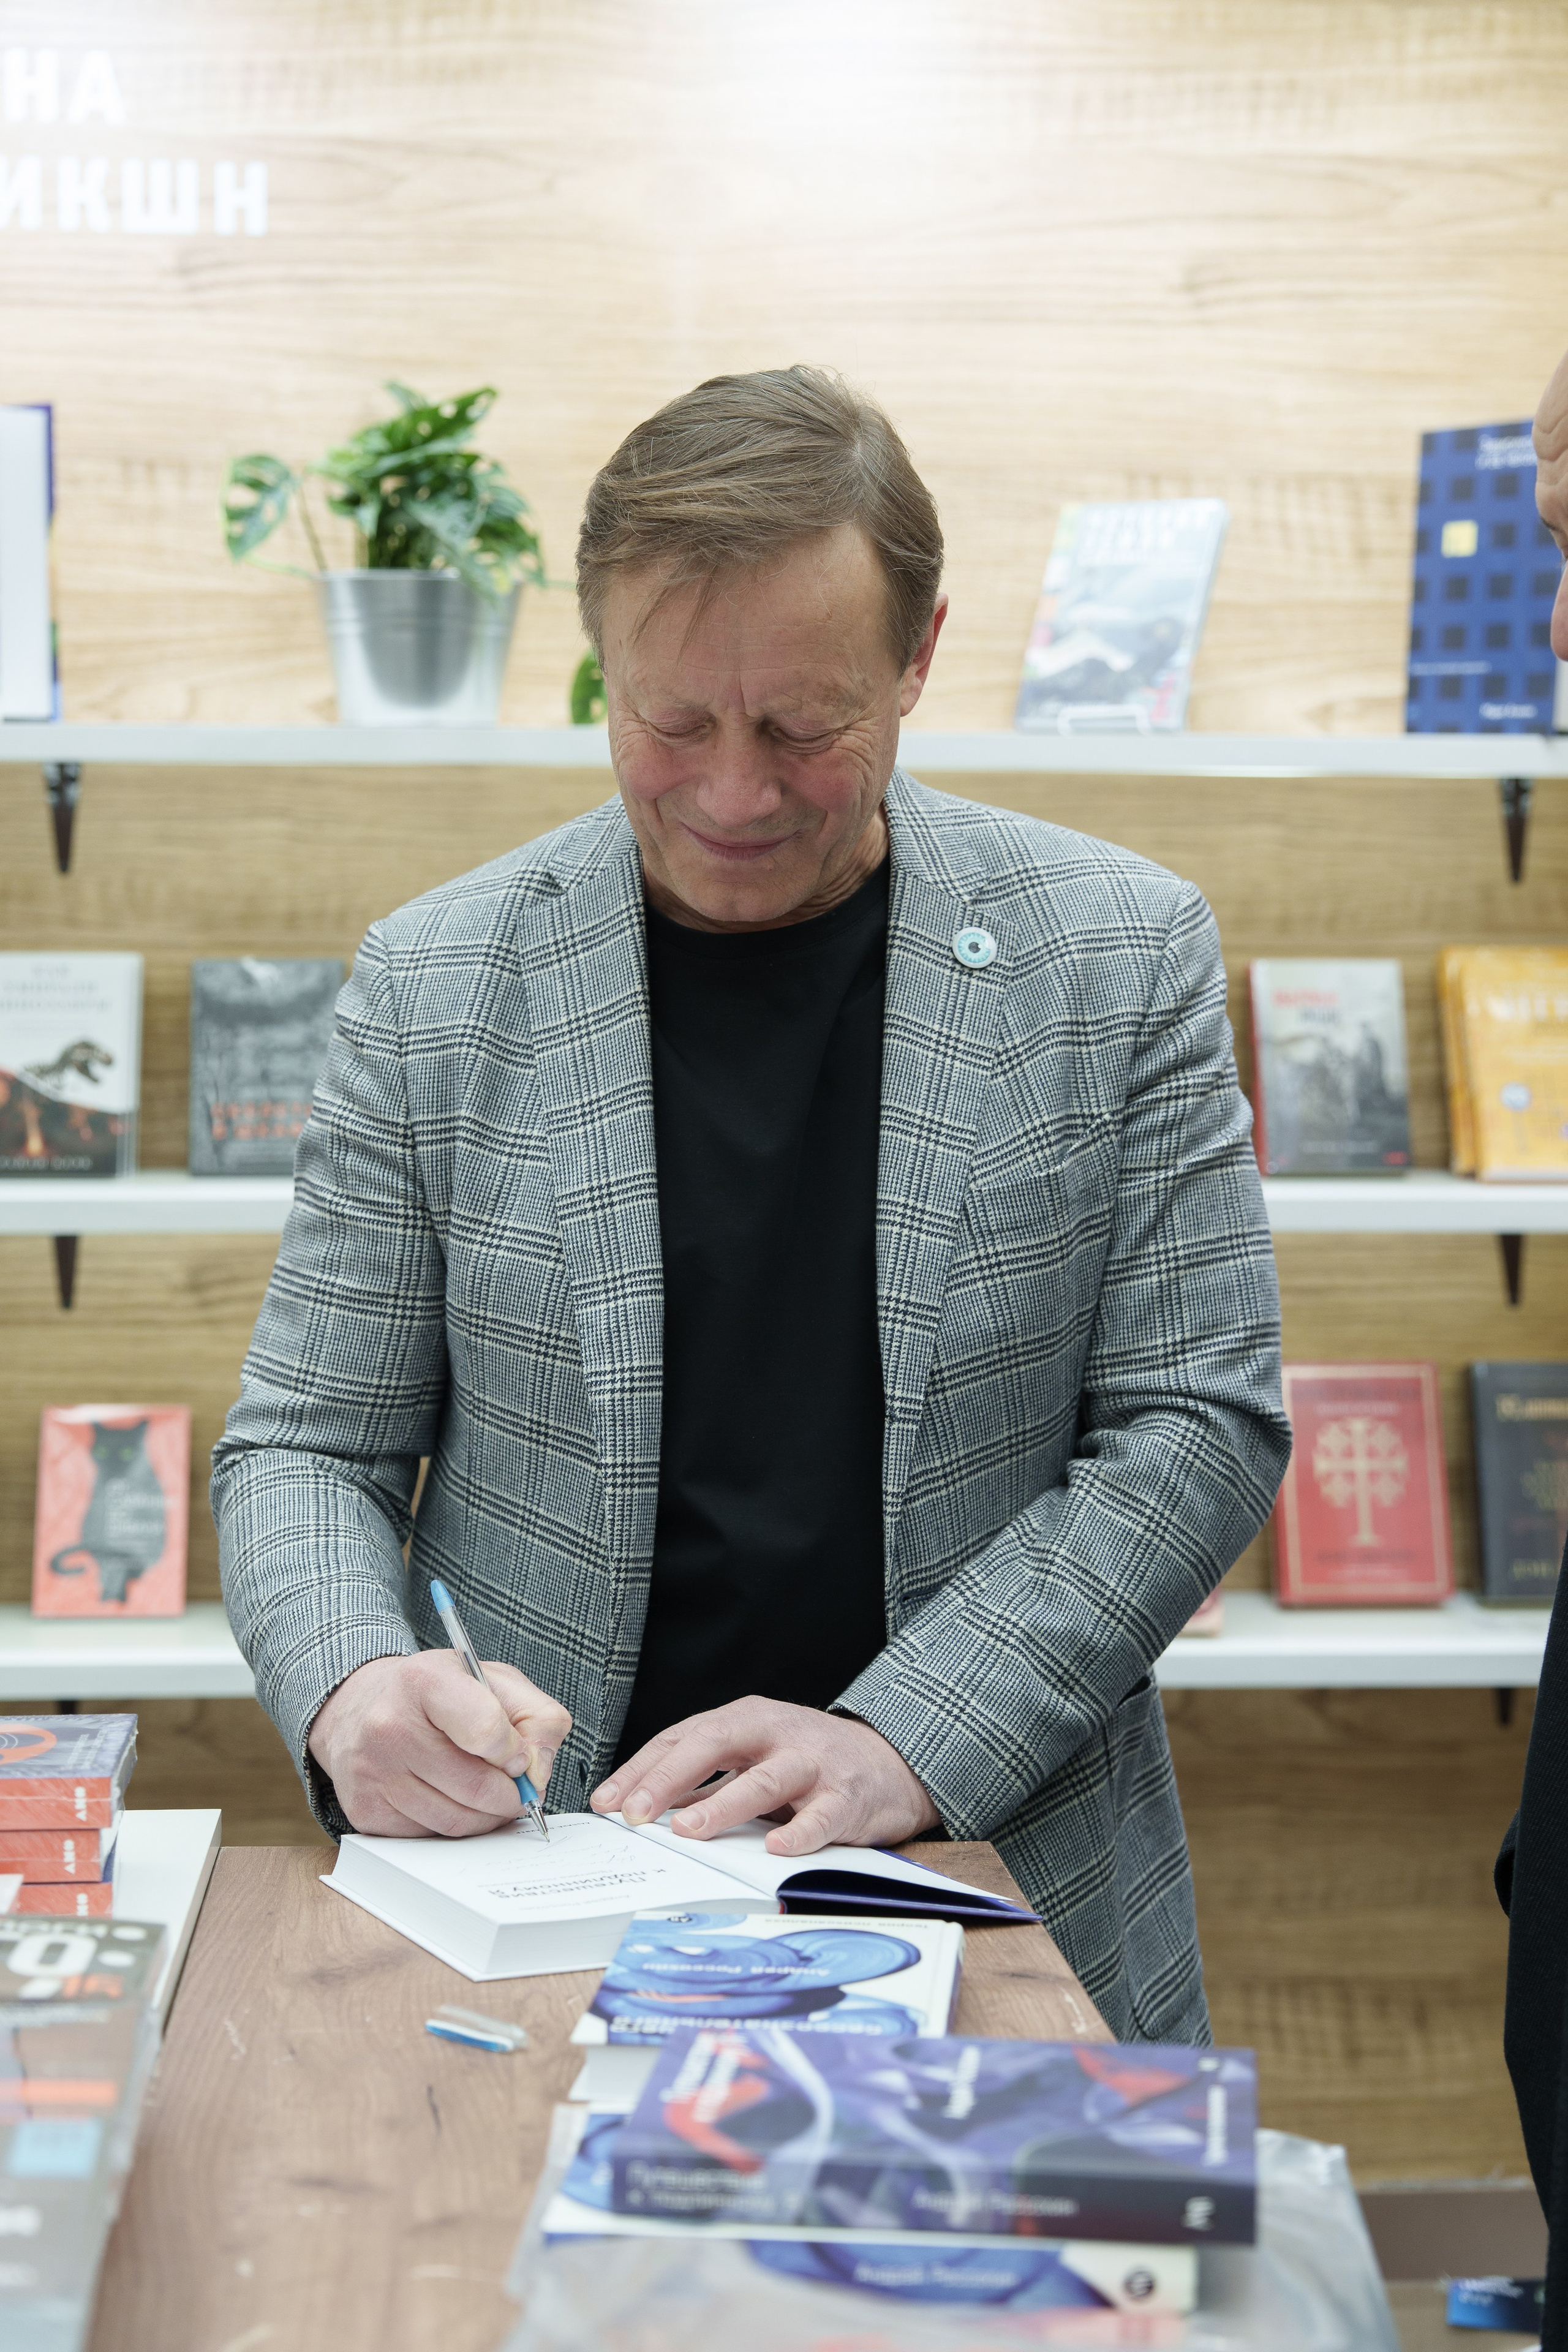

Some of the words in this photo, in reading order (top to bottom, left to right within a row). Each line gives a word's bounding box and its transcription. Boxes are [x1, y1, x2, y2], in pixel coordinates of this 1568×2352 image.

[497, 1877, 647, 1900] Путешествие
[511, 1870, 647, 1892] подлинному
[750, 1965, 831, 1977] Андрей
